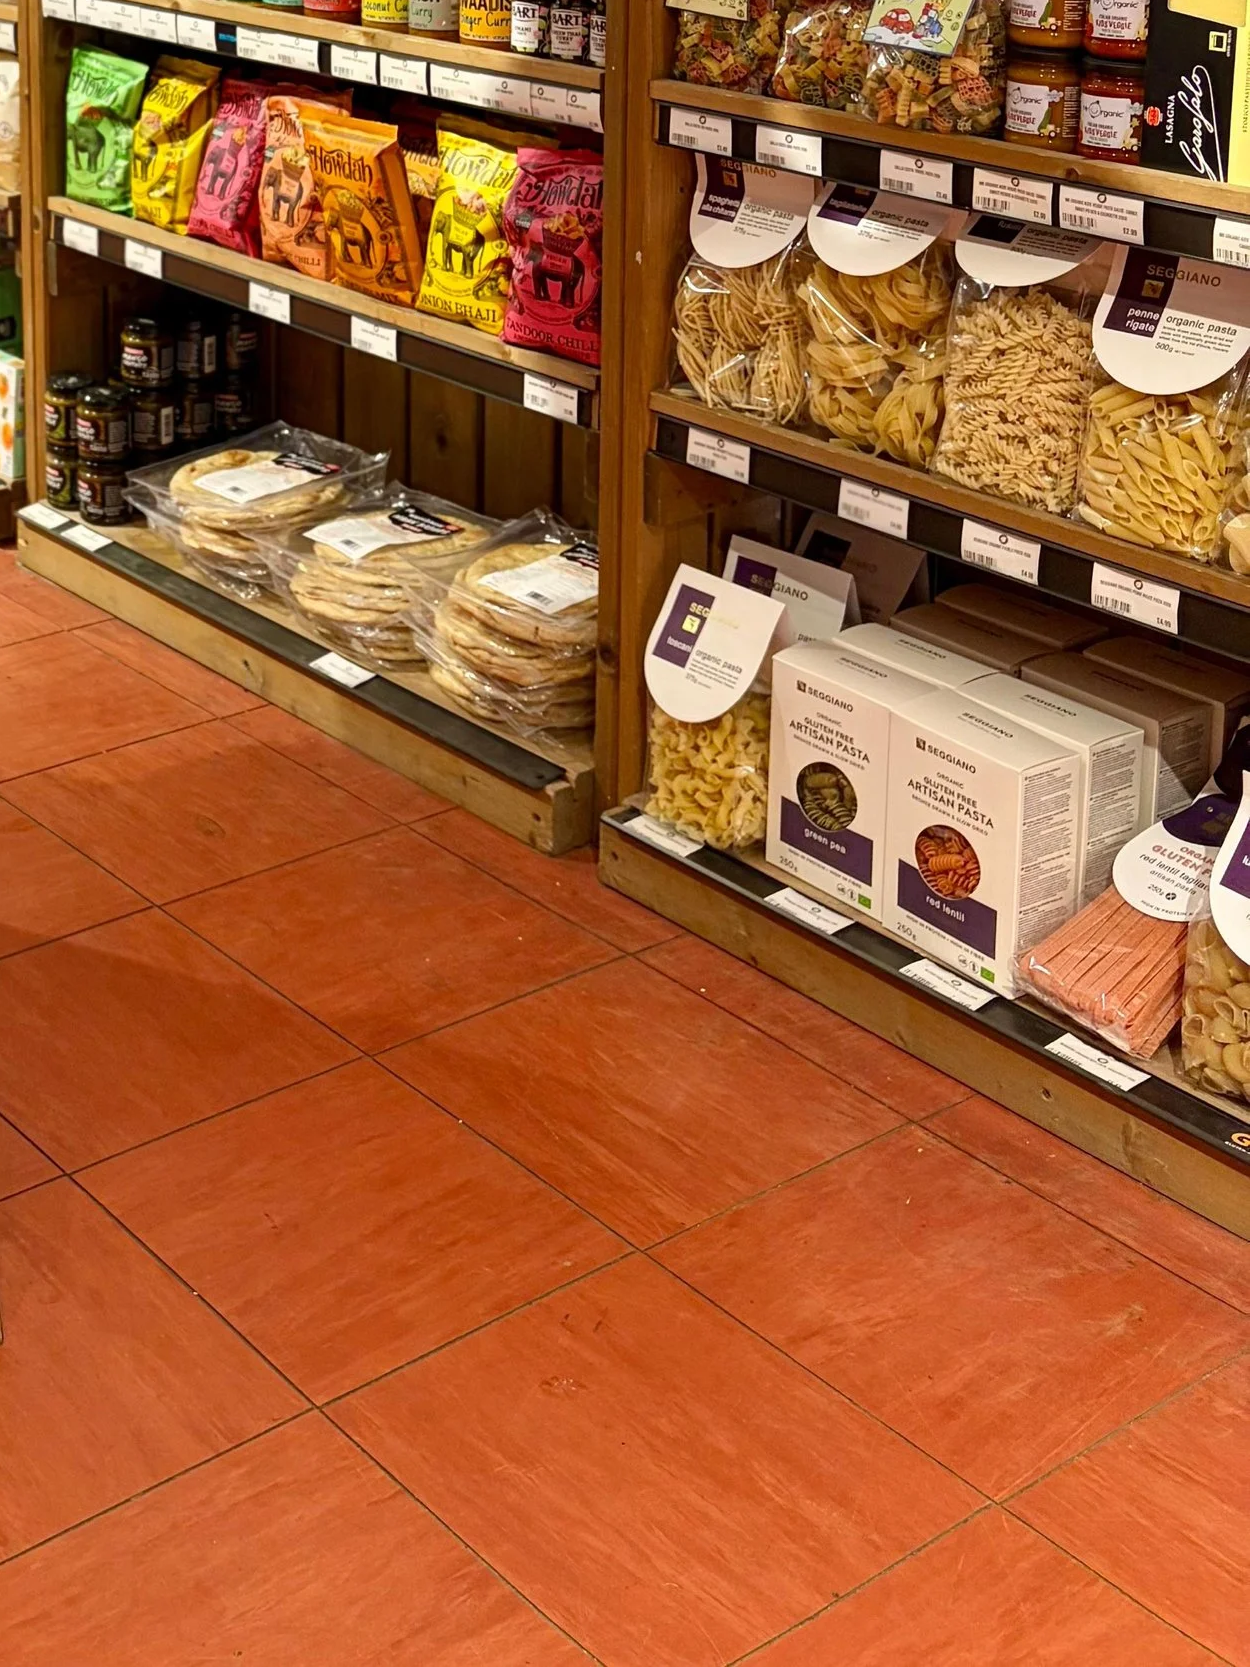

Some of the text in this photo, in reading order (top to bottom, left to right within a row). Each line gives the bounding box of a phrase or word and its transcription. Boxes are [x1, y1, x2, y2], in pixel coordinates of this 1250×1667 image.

[552, 13, 581, 26] BART
[1165, 94, 1176, 144] LASAGNA
[309, 143, 373, 189] Howdah
[744, 204, 794, 221] organic pasta
[872, 209, 929, 230] organic pasta
[1147, 265, 1221, 287] SEGGIANO
[421, 294, 498, 323] ONION BHAJI
[1127, 308, 1160, 320] penne
[1126, 320, 1155, 332] rigate
[1166, 315, 1237, 336] organic pasta
[1155, 342, 1173, 352] 500g
[807, 687, 854, 713] SEGGIANO
[789, 719, 870, 764] ARTISAN PASTA
[804, 717, 854, 745] GLUTEN FREE
[927, 744, 977, 774] SEGGIANO
[908, 779, 994, 829] ARTISAN PASTA
[924, 776, 978, 808] GLUTEN FREE
[804, 828, 846, 854] green pea
[1140, 853, 1181, 875] red lentil
[1152, 845, 1202, 872] GLUTEN
[1150, 869, 1197, 895] artisan pasta
[926, 895, 965, 923] red lentil
